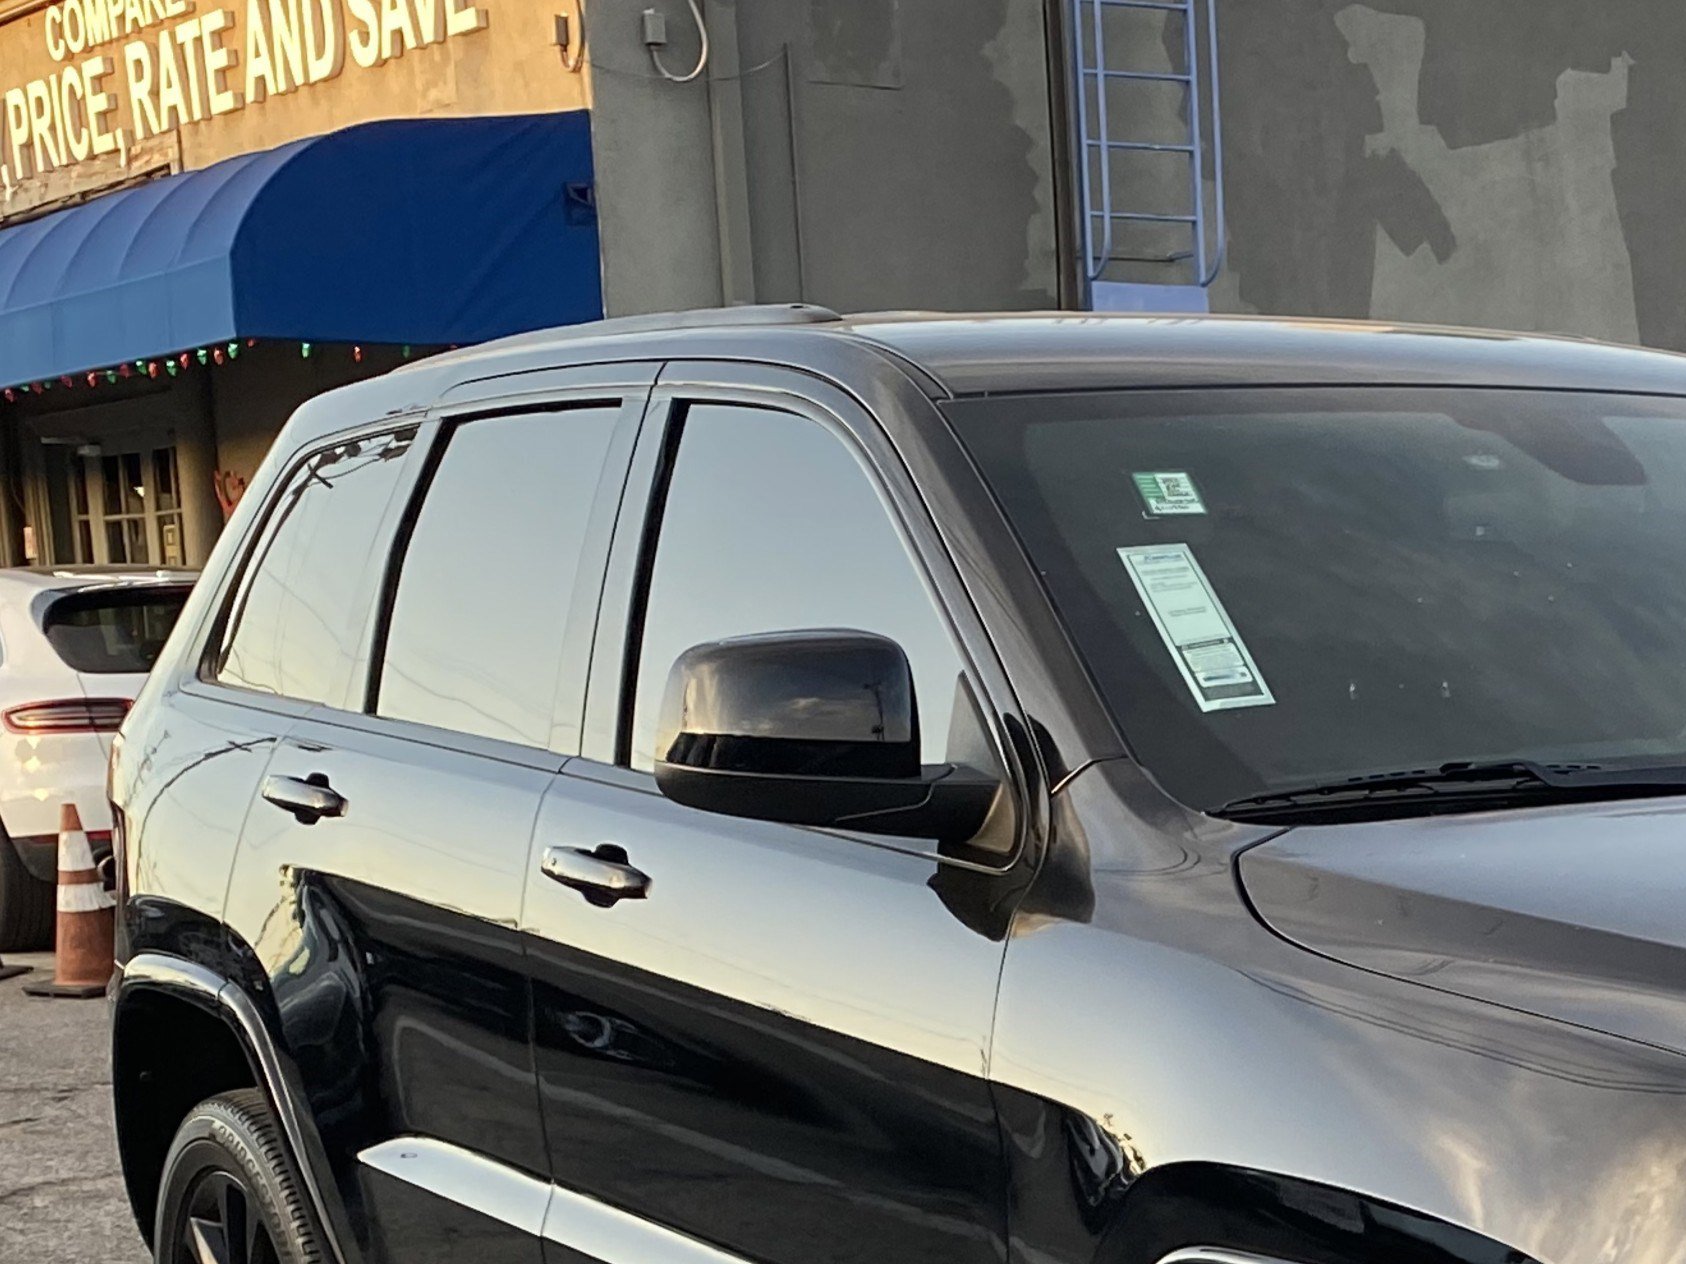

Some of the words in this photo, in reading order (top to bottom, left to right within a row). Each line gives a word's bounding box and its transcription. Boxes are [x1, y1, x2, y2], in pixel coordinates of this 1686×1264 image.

[5, 55, 128, 180] PRICE,
[124, 8, 236, 140] RATE
[245, 0, 336, 104] AND
